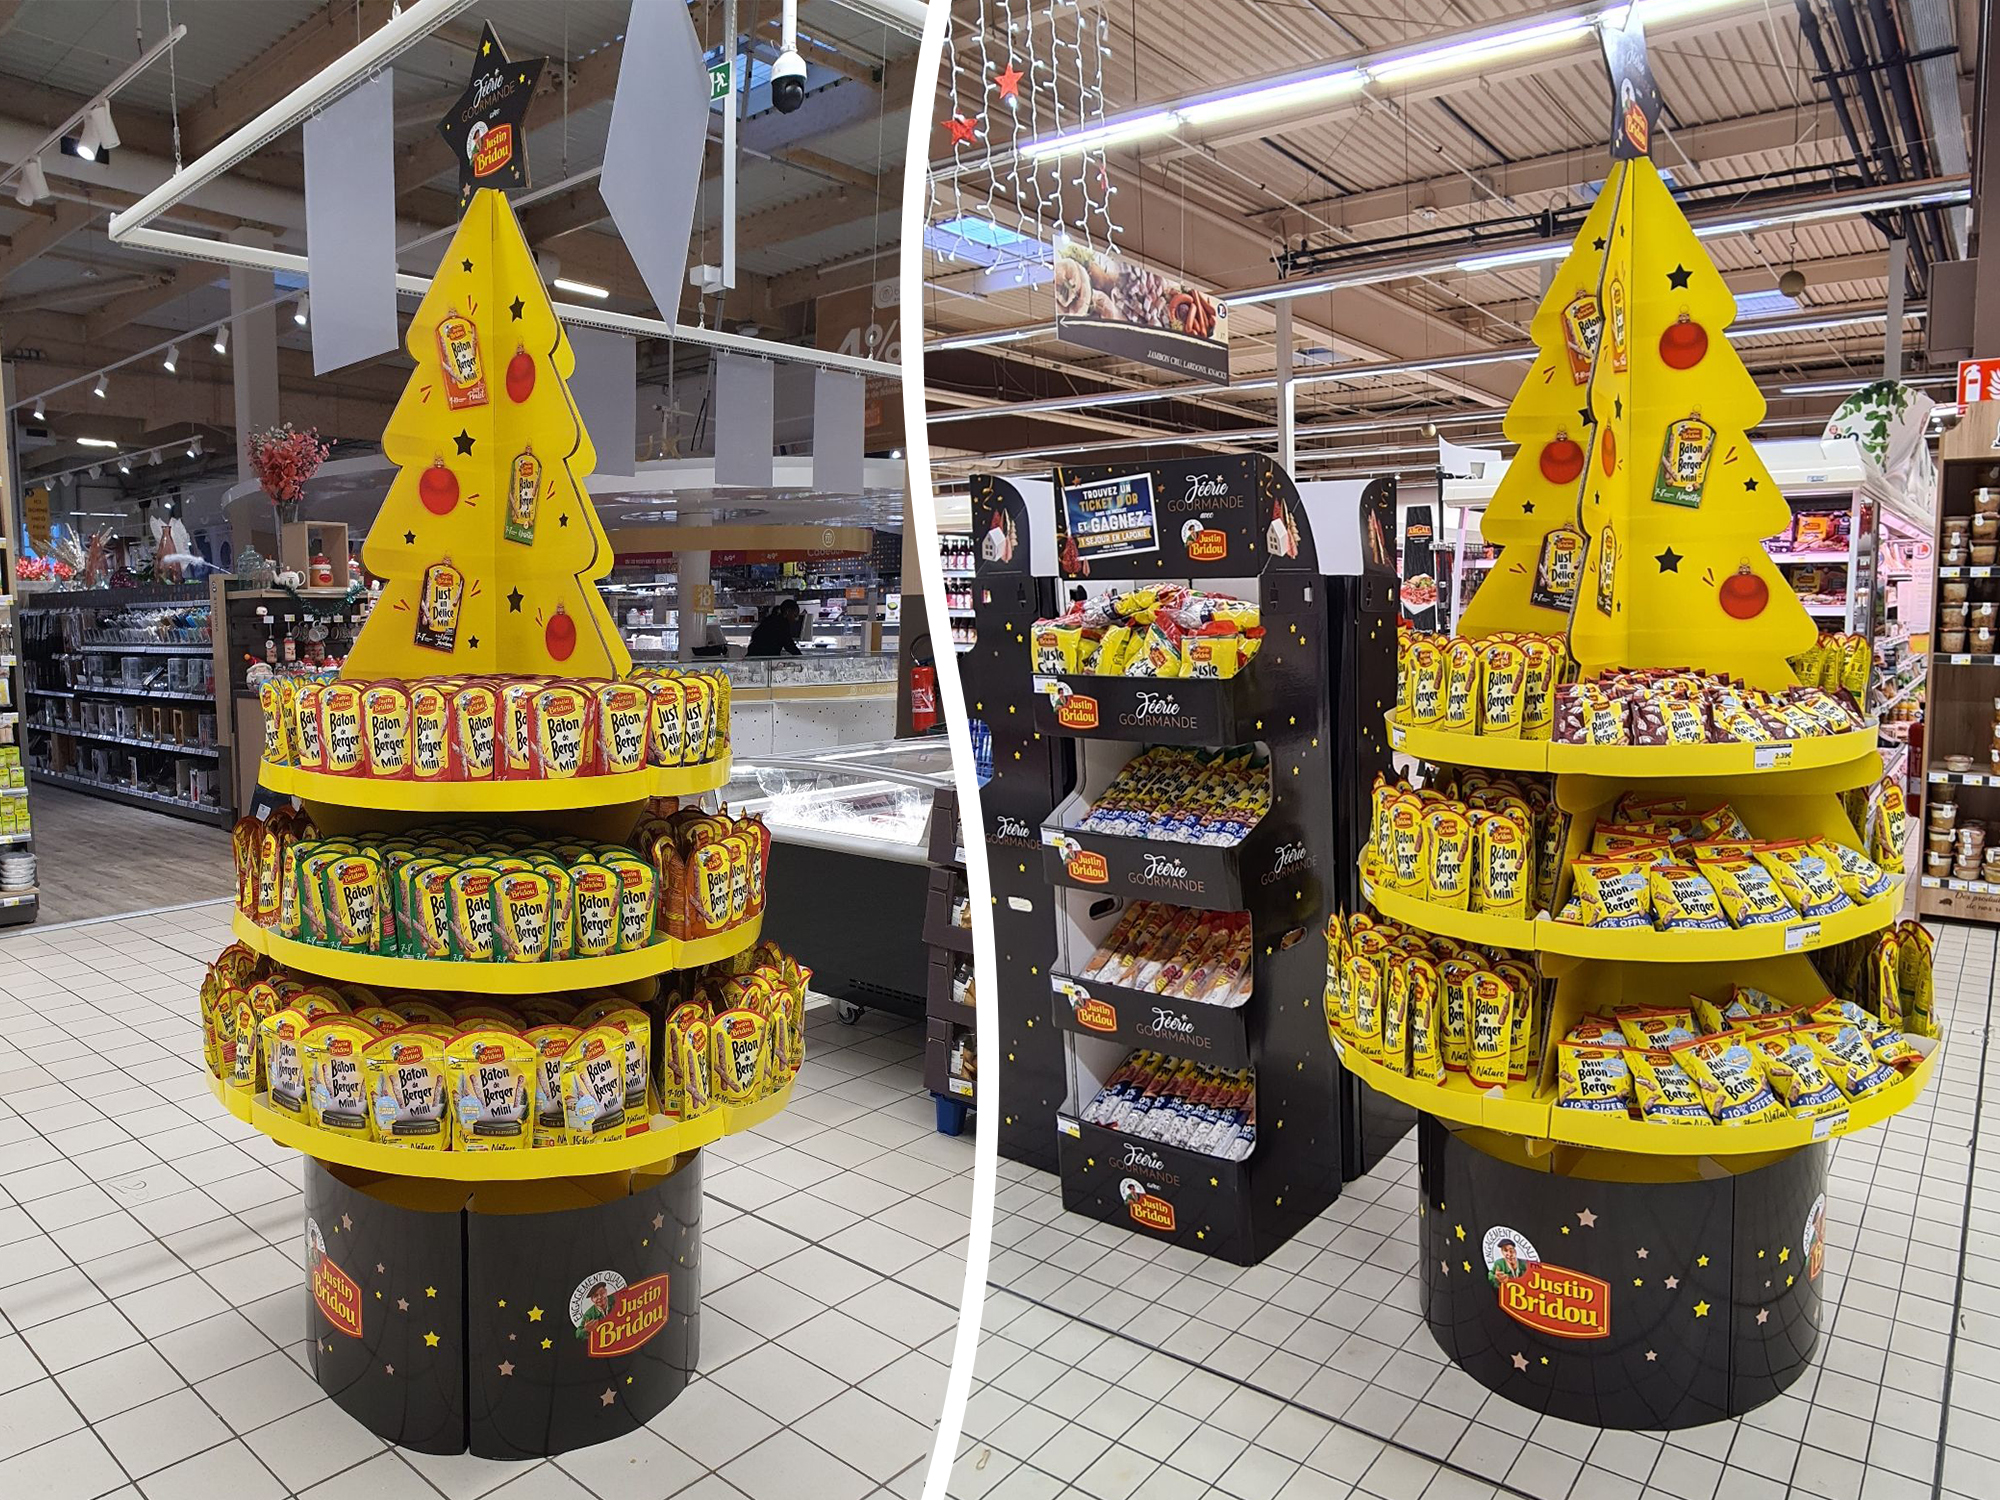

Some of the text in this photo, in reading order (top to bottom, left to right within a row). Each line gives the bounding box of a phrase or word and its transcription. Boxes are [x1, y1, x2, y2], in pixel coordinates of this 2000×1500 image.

[462, 81, 516, 122] GOURMANDE
[485, 131, 507, 151] Justin
[477, 144, 508, 170] Bridou
[1148, 350, 1170, 363] JAMBON
[1678, 458, 1702, 473] Berger
[1082, 484, 1131, 500] TROUVEZ UN
[1079, 497, 1112, 512] TICKET
[1116, 493, 1138, 507] D'OR
[1167, 495, 1244, 512] GOURMANDE
[1078, 521, 1088, 533] ET
[1199, 535, 1221, 544] Justin
[1192, 544, 1223, 556] Bridou
[1552, 550, 1573, 566] Just
[1552, 569, 1575, 582] Délice
[434, 586, 452, 603] Just
[1488, 671, 1513, 691] Bâton
[548, 704, 572, 714] Bridou
[1069, 700, 1093, 710] Justin
[1487, 693, 1515, 712] Berger
[657, 703, 679, 729] Just
[1061, 709, 1095, 722] Bridou
[1119, 713, 1197, 729] GOURMANDE
[1418, 707, 1436, 719] Mini
[1491, 711, 1510, 724] Mini
[329, 712, 356, 733] Bâton
[372, 716, 400, 736] Bâton
[417, 716, 438, 738] Bâton
[468, 716, 493, 739] Bâton
[547, 718, 579, 740] Bâton
[611, 713, 641, 734] Bâton
[668, 723, 677, 731] un
[331, 734, 359, 753] Berger
[374, 737, 404, 757] Berger
[418, 738, 442, 758] Berger
[337, 753, 357, 764] Mini
[381, 756, 403, 769] Mini
[1775, 751, 1792, 759] 2.39€
[421, 758, 440, 770] Mini
[986, 833, 1043, 850] GOURMANDE
[1438, 838, 1458, 858] Bâton
[1078, 855, 1101, 867] Justin
[1490, 844, 1517, 865] Bâton
[344, 872, 366, 881] Bridou
[1072, 863, 1104, 878] Bridou
[1261, 855, 1317, 885] GOURMANDE
[1399, 869, 1415, 880] Mini
[1436, 861, 1461, 880] Berger
[1490, 865, 1519, 887] Berger
[1128, 872, 1205, 892] GOURMANDE
[1438, 879, 1458, 891] Mini
[1739, 881, 1768, 896] Bâtons
[1809, 879, 1837, 900] Berger
[343, 884, 374, 907] Bâton
[1493, 888, 1514, 900] Mini
[1750, 894, 1782, 910] Berger
[510, 902, 543, 923] Bâton
[579, 893, 610, 915] Bâton
[1605, 898, 1638, 914] Berger
[1680, 901, 1715, 917] Berger
[513, 923, 545, 943] Berger
[580, 915, 613, 936] Berger
[588, 936, 609, 949] Mini
[625, 931, 645, 944] Mini
[523, 944, 543, 955] Mini
[1086, 1003, 1111, 1016] Justin
[1475, 998, 1499, 1018] Bâton
[1080, 1009, 1113, 1027] Bridou
[1135, 1023, 1211, 1049] GOURMANDE
[1474, 1022, 1502, 1041] Berger
[732, 1038, 759, 1061] Bâton
[1477, 1041, 1498, 1053] Mini
[400, 1054, 420, 1062] Bridou
[480, 1053, 503, 1062] Bridou
[331, 1060, 356, 1078] Bâton
[586, 1060, 612, 1084] Bâton
[1476, 1065, 1505, 1077] Nature
[398, 1068, 428, 1088] Bâton
[480, 1068, 510, 1088] Bâton
[625, 1077, 641, 1090] Mini
[1655, 1076, 1690, 1089] Bâtons
[333, 1081, 359, 1098] Berger
[402, 1087, 433, 1107] Berger
[484, 1086, 514, 1107] Berger
[593, 1078, 618, 1103] Berger
[1580, 1081, 1616, 1097] Berger
[1662, 1088, 1698, 1102] Berger
[1725, 1076, 1759, 1102] Berger
[338, 1098, 357, 1108] Mini
[603, 1096, 618, 1112] Mini
[1569, 1101, 1588, 1110] 10%
[1805, 1096, 1821, 1106] 10%
[409, 1105, 431, 1117] Mini
[491, 1105, 511, 1117] Mini
[1659, 1106, 1679, 1115] 10%
[1728, 1106, 1749, 1116] 10%
[1108, 1157, 1180, 1186] GOURMANDE
[1133, 1203, 1171, 1225] Bridou
[1141, 1197, 1168, 1214] Justin
[1484, 1227, 1511, 1264] ENGAGEMENT
[322, 1264, 353, 1302] Justin
[1528, 1271, 1593, 1303] Justin
[314, 1270, 356, 1327] Bridou
[571, 1273, 602, 1323] ENGAGEMENT
[617, 1285, 661, 1317] Justin
[1506, 1282, 1598, 1327] Bridou
[596, 1305, 663, 1348] Bridou
